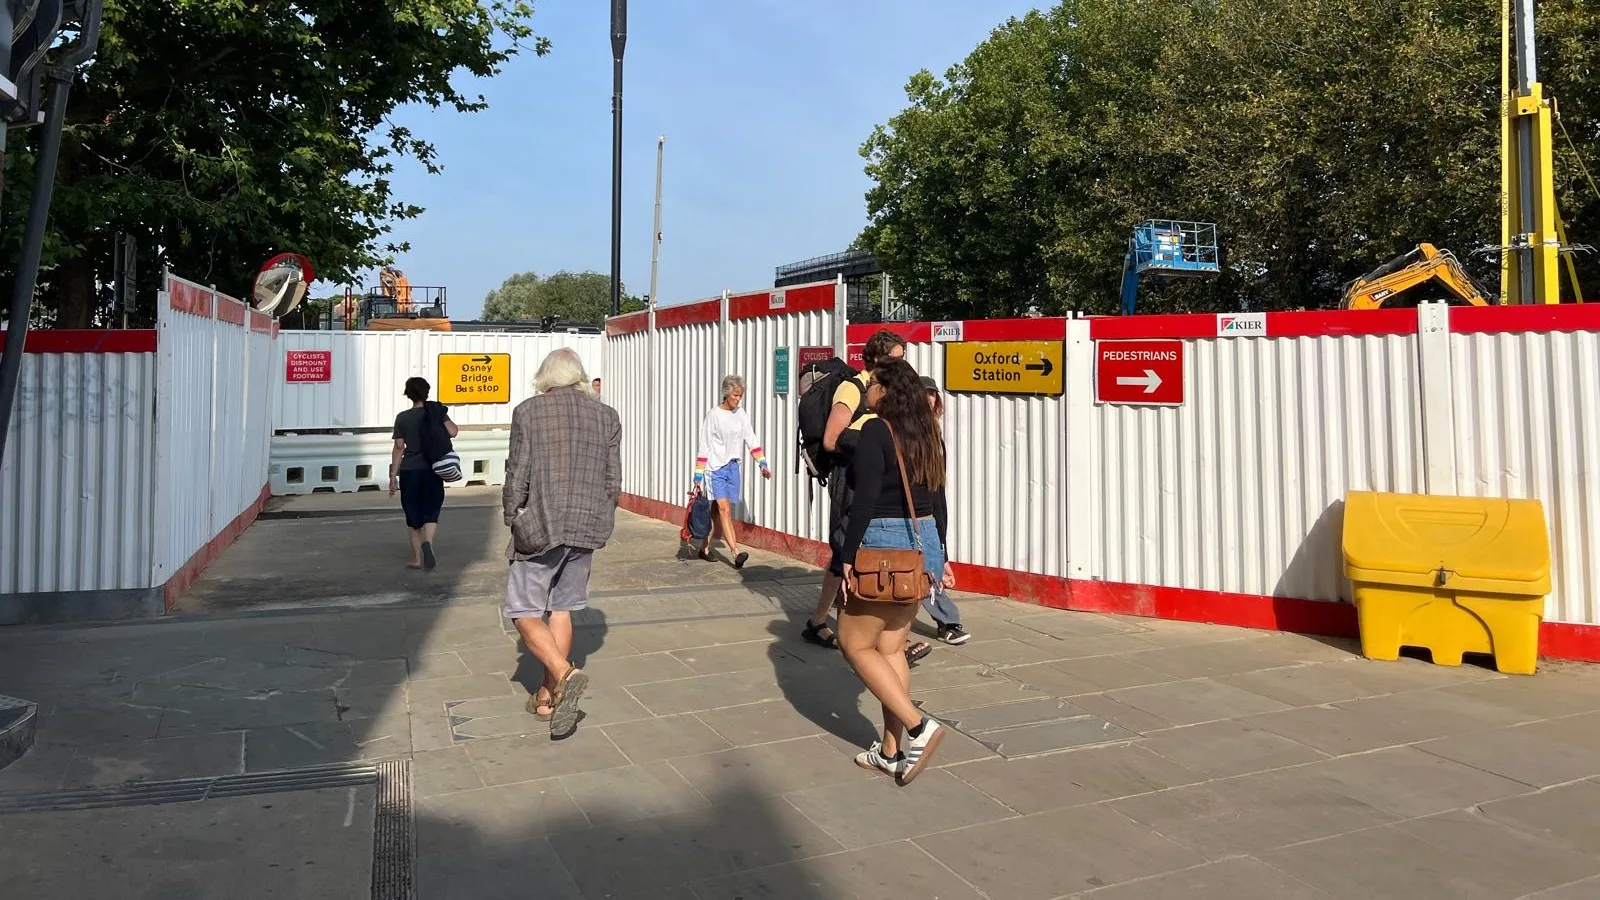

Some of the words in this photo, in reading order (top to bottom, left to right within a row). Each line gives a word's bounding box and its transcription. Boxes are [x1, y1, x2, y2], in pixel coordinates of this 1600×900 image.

[1235, 320, 1262, 330] KIER
[942, 328, 961, 336] KIER
[974, 352, 1021, 365] Oxford
[1103, 351, 1177, 361] PEDESTRIANS
[462, 363, 492, 373] Osney
[461, 374, 494, 383] Bridge
[972, 368, 1021, 381] Station
[477, 384, 499, 393] stop
